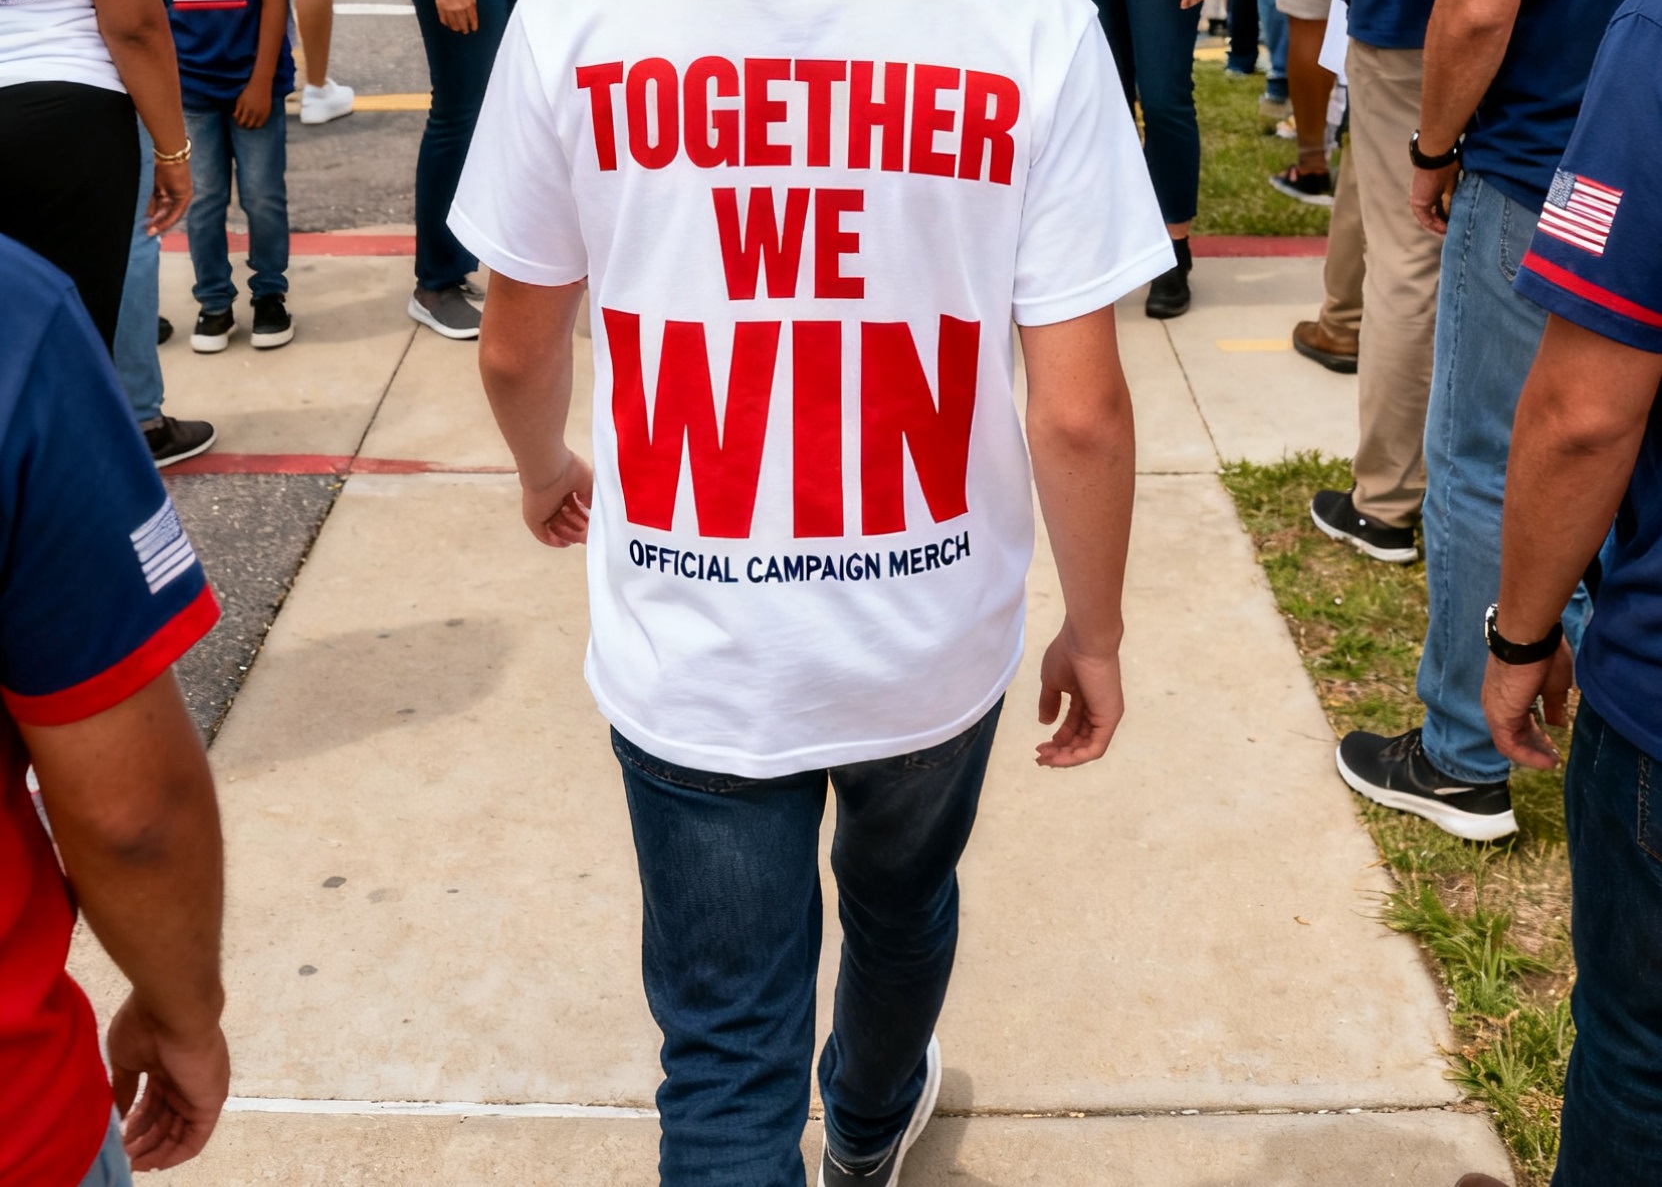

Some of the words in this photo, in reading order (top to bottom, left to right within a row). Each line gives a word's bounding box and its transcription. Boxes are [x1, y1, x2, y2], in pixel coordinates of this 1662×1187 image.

[576, 55, 1021, 186] TOGETHER
[712, 187, 865, 301] WE
[601, 306, 981, 539] WIN
[628, 539, 739, 584] OFFICIAL
[746, 551, 881, 584] CAMPAIGN
[889, 530, 971, 579] MERCH
